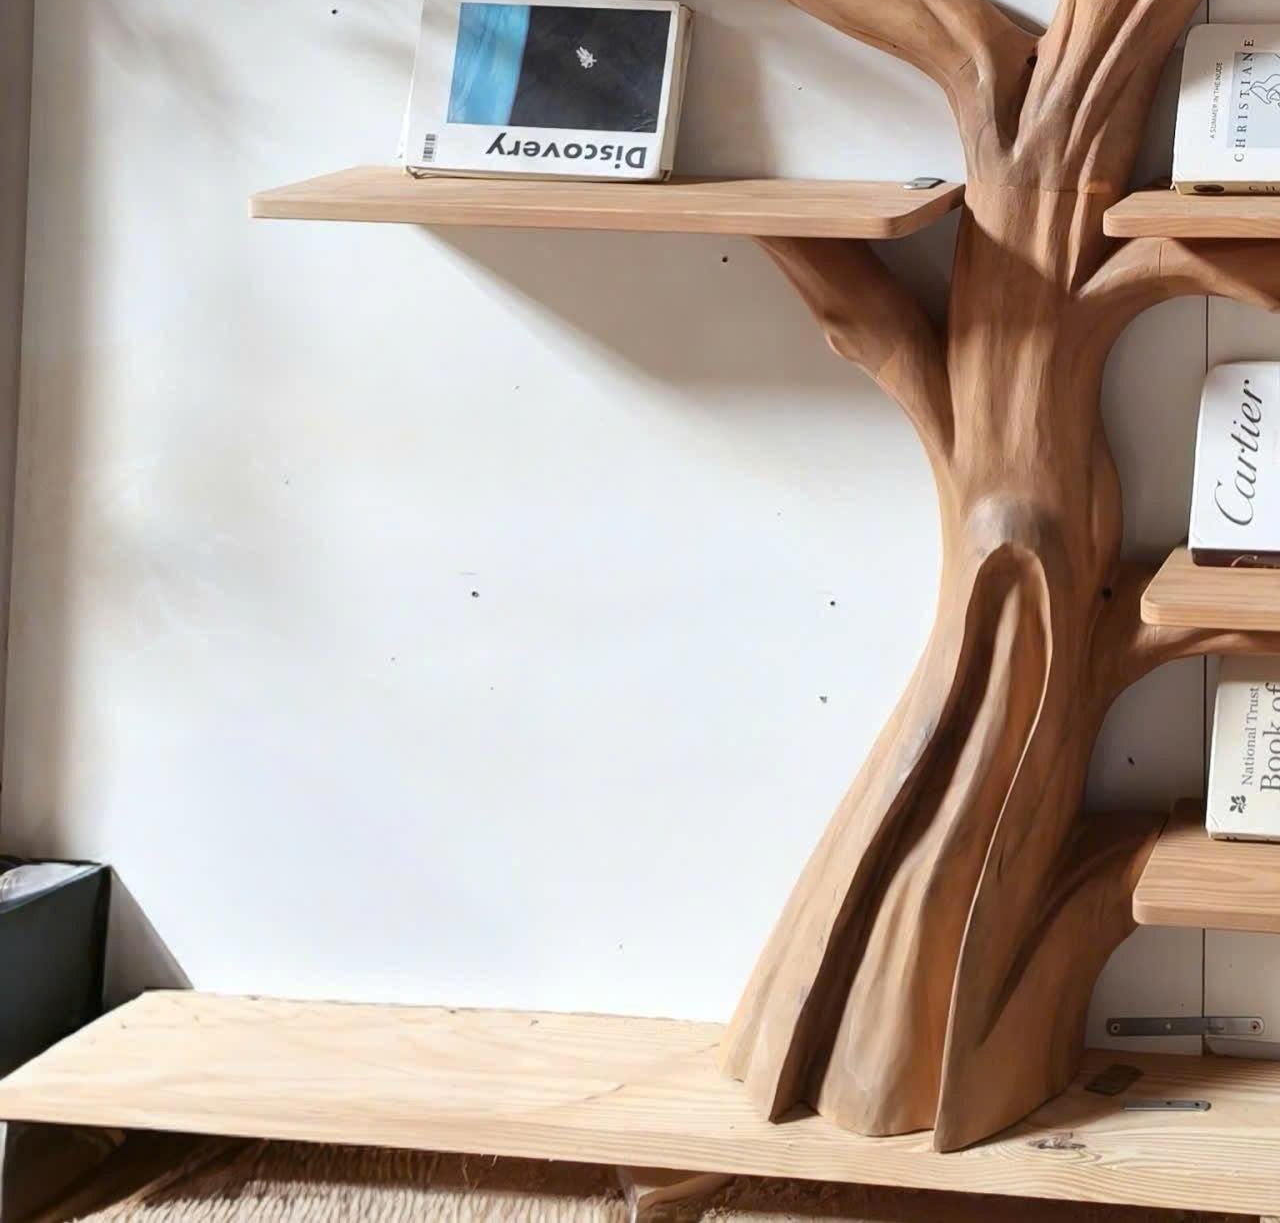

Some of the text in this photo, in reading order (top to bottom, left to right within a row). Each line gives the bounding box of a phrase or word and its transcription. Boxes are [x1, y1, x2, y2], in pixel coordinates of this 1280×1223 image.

[1214, 61, 1223, 80] NUDE
[1234, 39, 1255, 163] CHRISTIANE
[485, 132, 648, 169] Discovery
[1214, 378, 1264, 527] Cartier
[1241, 686, 1260, 787] National Trust
